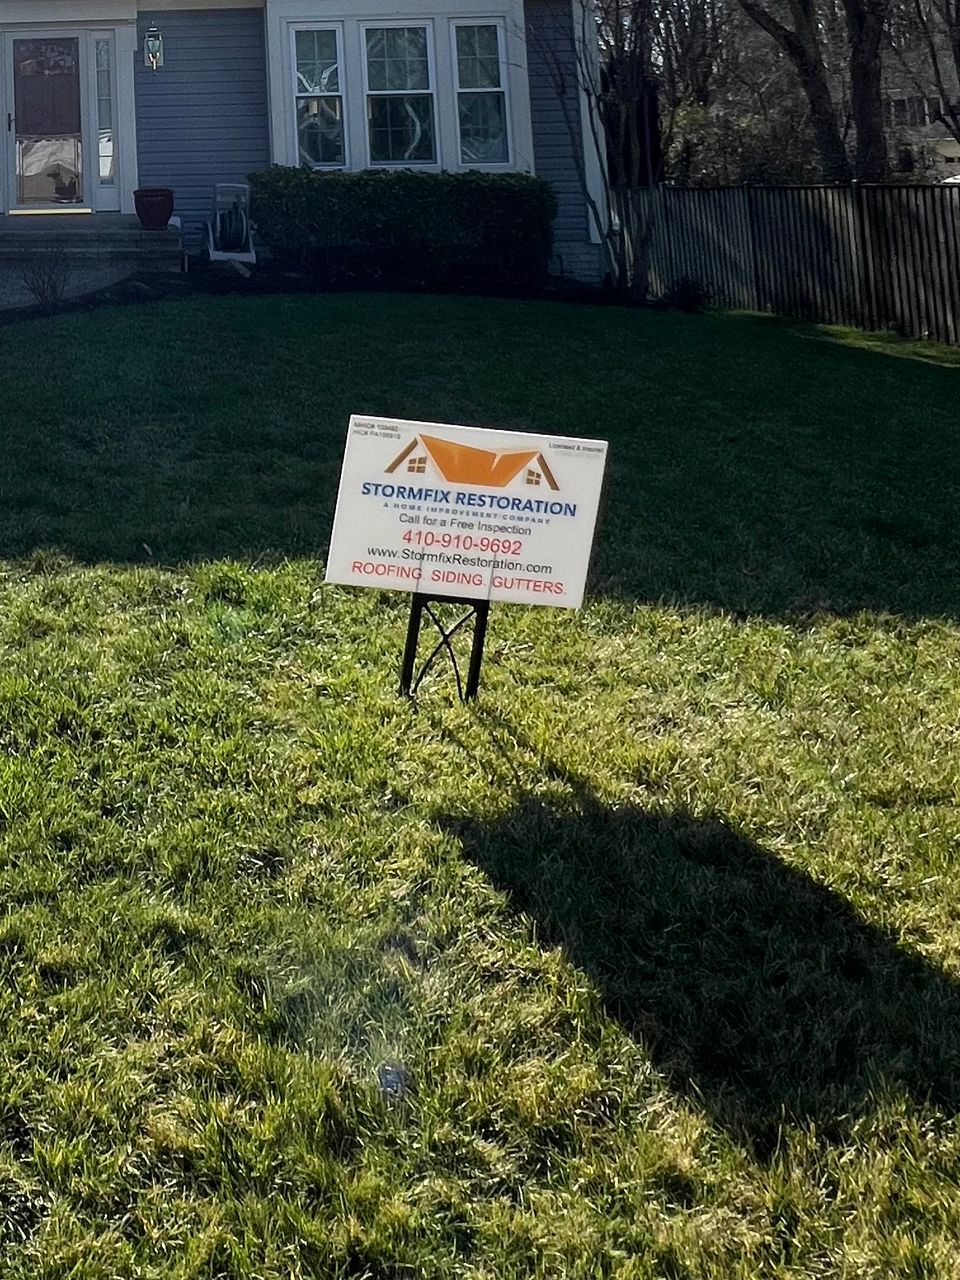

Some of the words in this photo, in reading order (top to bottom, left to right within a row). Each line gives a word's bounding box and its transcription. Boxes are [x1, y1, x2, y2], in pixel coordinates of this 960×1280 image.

[361, 482, 451, 504] STORMFIX
[455, 492, 577, 517] RESTORATION
[393, 503, 422, 512] HOME
[426, 506, 498, 519] IMPROVEMENT
[502, 514, 551, 525] COMPANY
[398, 513, 420, 525] Call
[422, 515, 437, 526] for
[439, 519, 447, 528] a
[450, 518, 474, 531] Free
[477, 521, 532, 537] Inspection
[402, 529, 523, 556] 410-910-9692
[367, 547, 553, 575] www.StormfixRestoration.com
